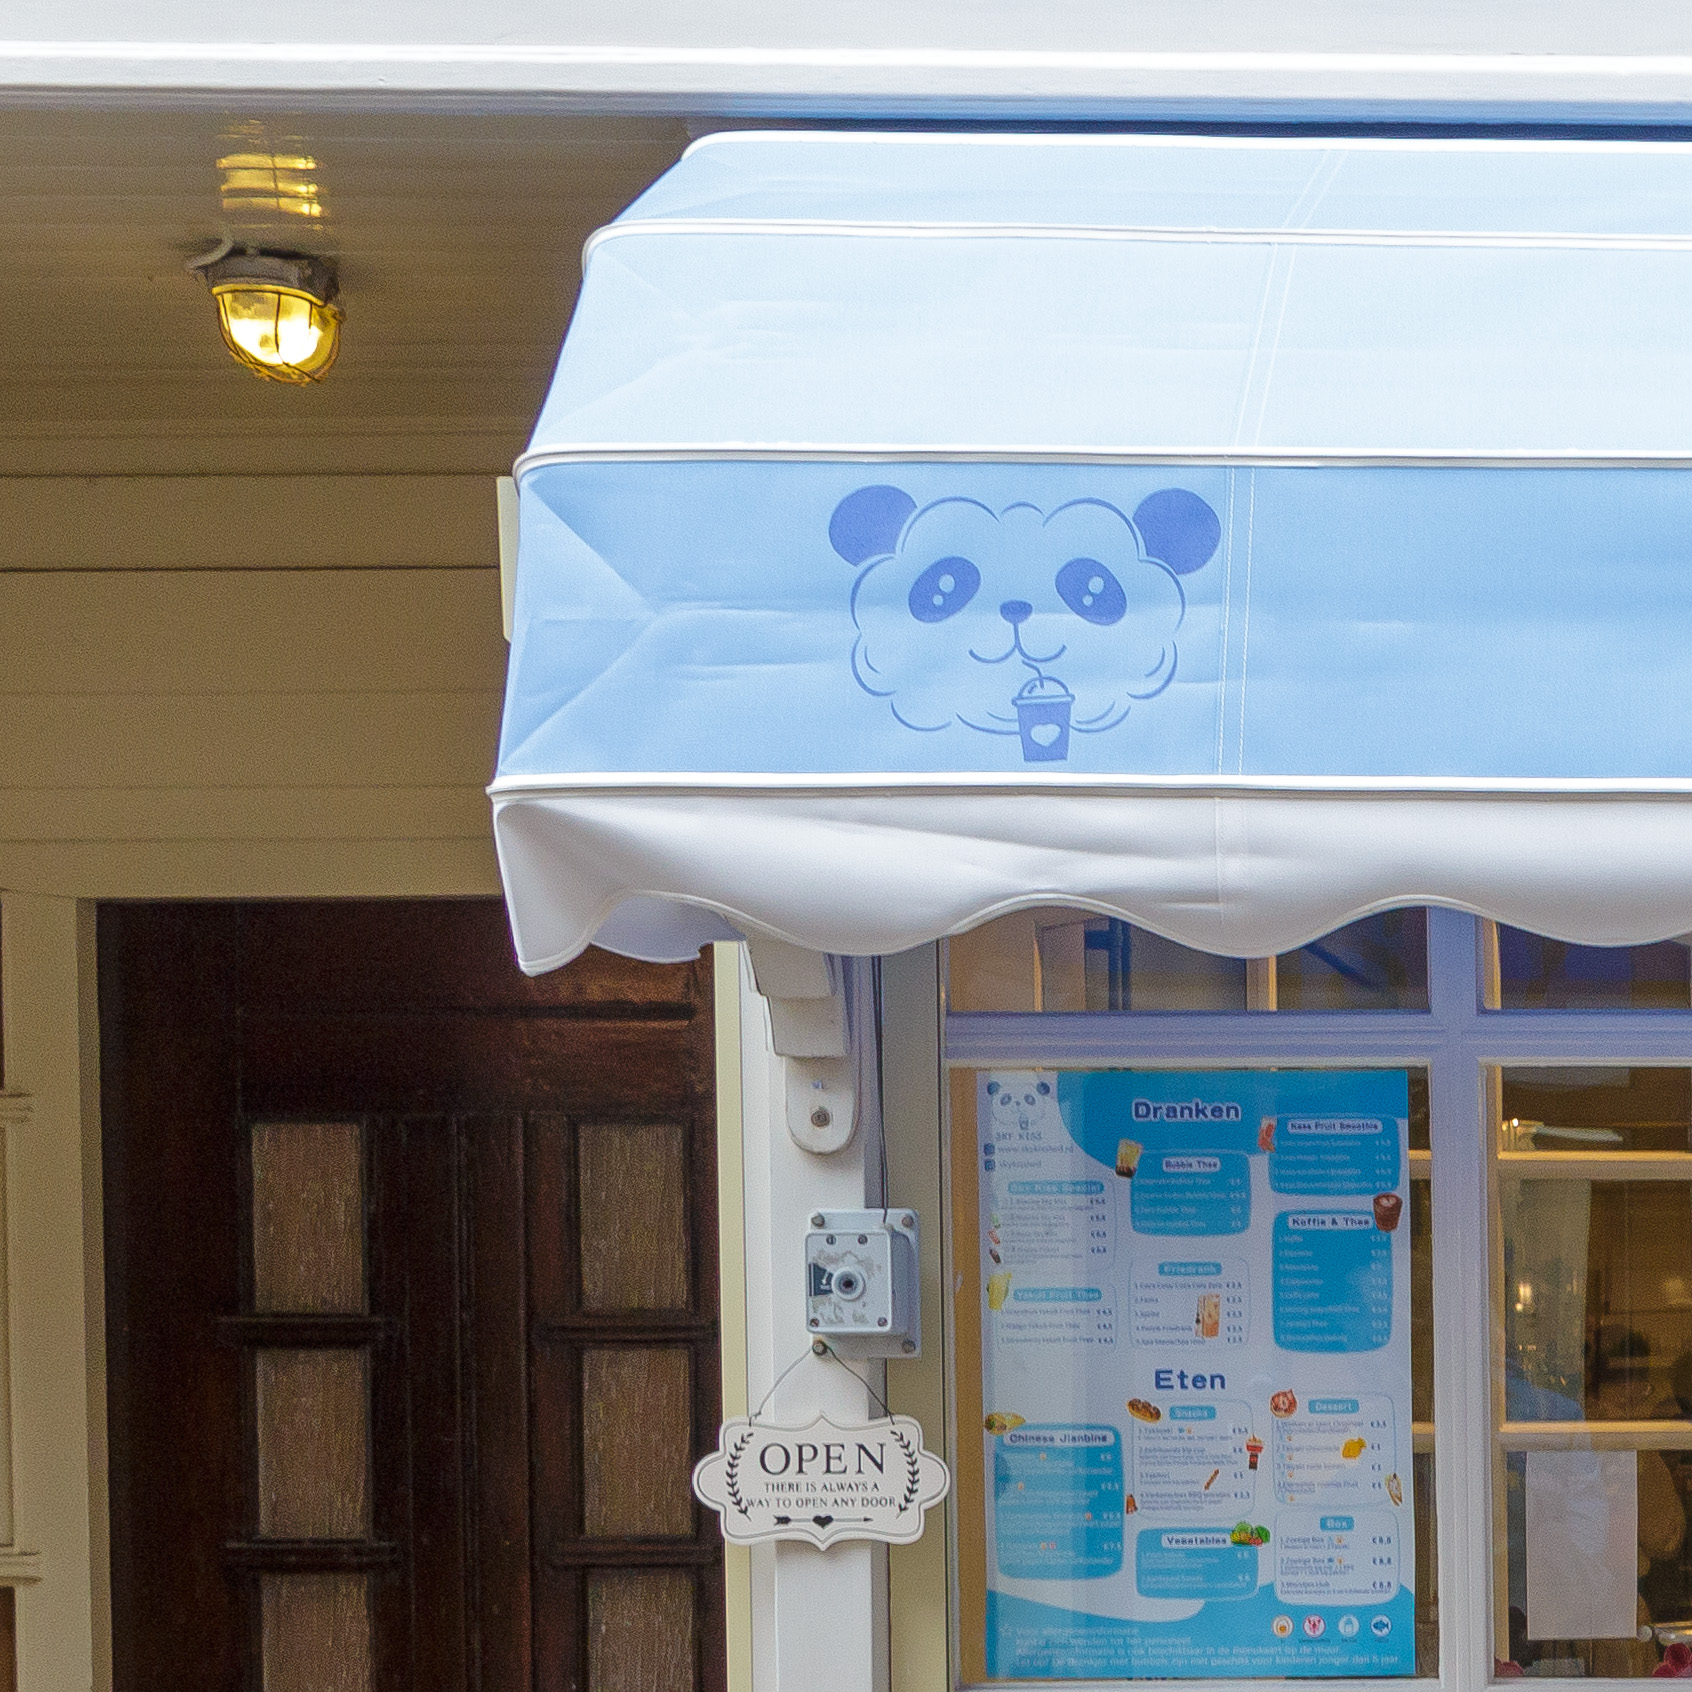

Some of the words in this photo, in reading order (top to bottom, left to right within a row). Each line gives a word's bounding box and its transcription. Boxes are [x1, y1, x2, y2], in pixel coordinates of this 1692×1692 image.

[1133, 1100, 1241, 1120] Dranken
[1292, 1217, 1327, 1227] Koffie
[1343, 1217, 1370, 1227] Thee
[1154, 1368, 1226, 1390] Eten
[1009, 1433, 1056, 1444] Chinese
[759, 1442, 887, 1477] OPEN
[763, 1481, 802, 1494] THERE
[805, 1481, 817, 1493] IS
[820, 1481, 868, 1493] ALWAYS
[869, 1481, 880, 1492] A
[746, 1496, 771, 1509] WAY
[775, 1497, 793, 1509] TO
[796, 1496, 829, 1508] OPEN
[831, 1496, 858, 1508] ANY
[860, 1496, 896, 1508] DOOR
